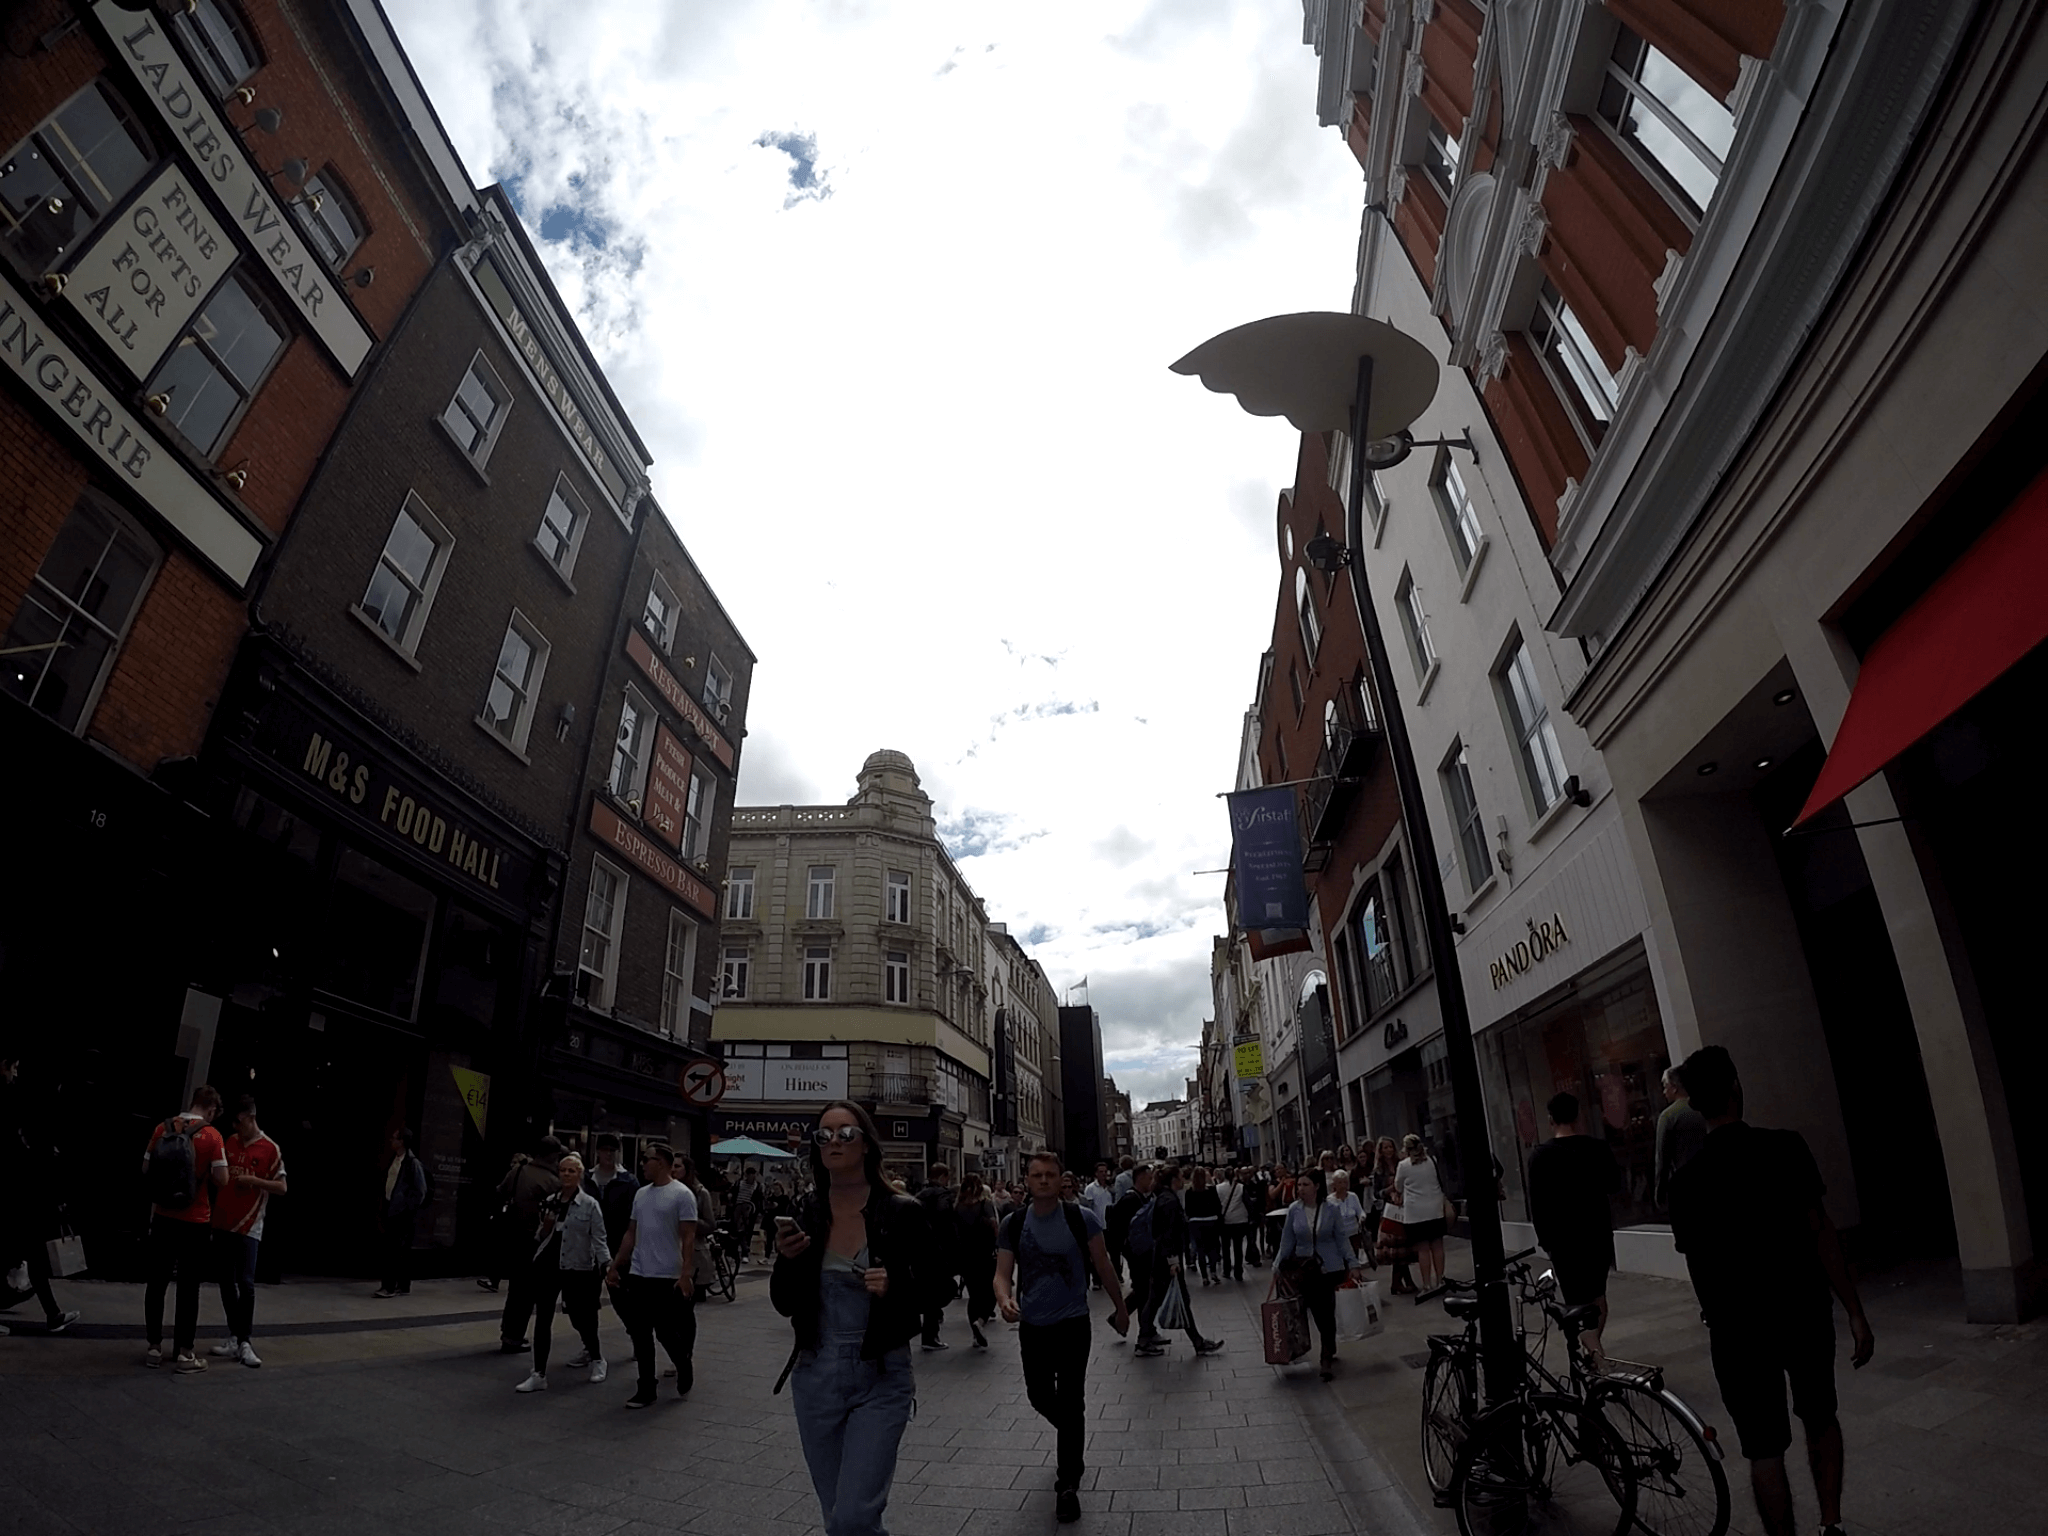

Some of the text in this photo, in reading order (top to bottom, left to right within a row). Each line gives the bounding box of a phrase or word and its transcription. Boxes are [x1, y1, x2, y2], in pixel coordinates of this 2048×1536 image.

[123, 18, 324, 317] LADIES WEAR
[134, 206, 201, 297] GIFTS
[162, 182, 219, 260] FINE
[112, 242, 165, 317] FOR
[84, 286, 139, 350] ALL
[649, 654, 719, 749] RESTAURANT
[91, 809, 106, 828] 18
[303, 732, 500, 889] M&S FOOD HALL
[654, 777, 674, 807] MEAT
[614, 819, 699, 903] ESPRESSO BAR
[1490, 913, 1567, 990] PANDORA
[724, 1073, 745, 1083] night
[785, 1077, 828, 1092] Hines
[725, 1120, 811, 1133] PHARMACY
